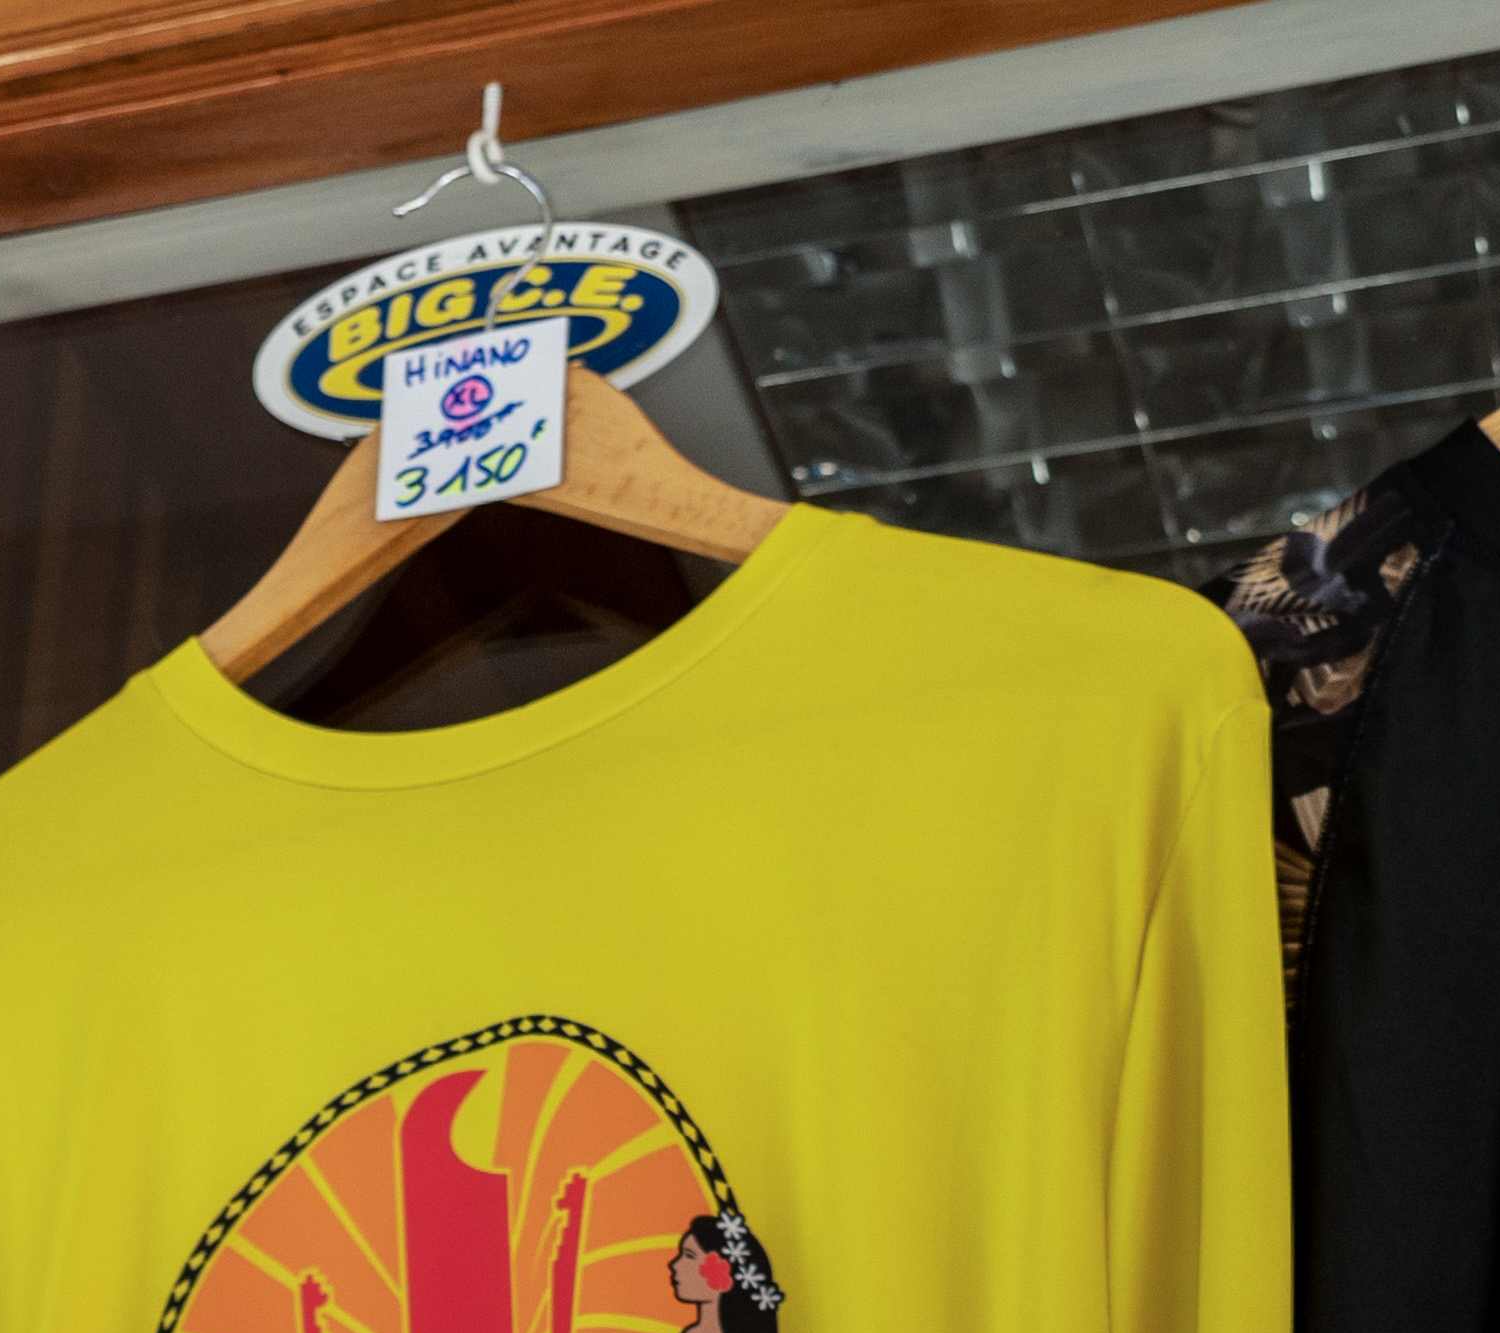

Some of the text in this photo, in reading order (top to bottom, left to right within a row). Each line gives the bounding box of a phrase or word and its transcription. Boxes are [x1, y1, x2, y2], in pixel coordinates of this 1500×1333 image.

[292, 231, 688, 338] ESPACE AVANTAGE
[328, 276, 476, 363] BIG
